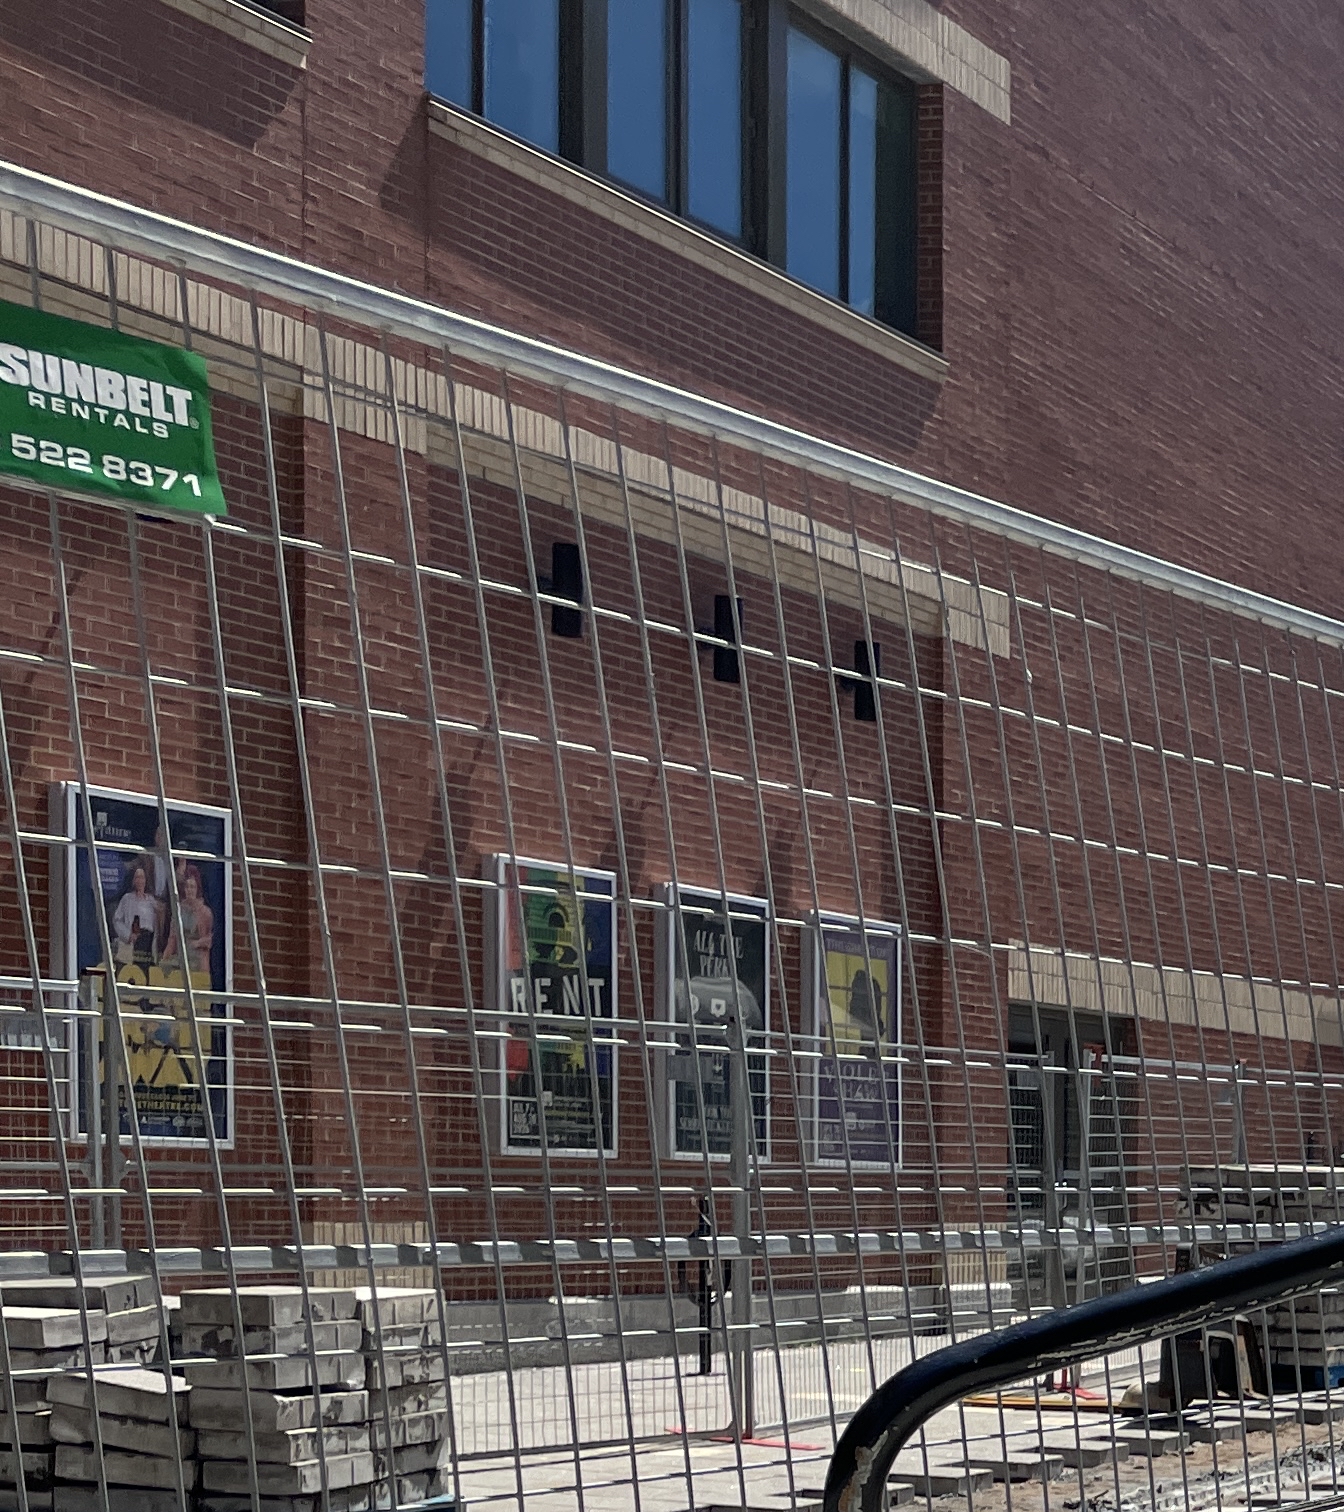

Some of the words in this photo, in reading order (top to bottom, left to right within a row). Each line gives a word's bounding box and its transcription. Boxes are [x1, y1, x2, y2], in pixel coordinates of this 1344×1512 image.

[0, 343, 192, 427] SUNBELT
[28, 390, 169, 438] RENTALS
[11, 433, 94, 474] 522
[102, 454, 202, 497] 8371
[511, 974, 605, 1017] RENT
